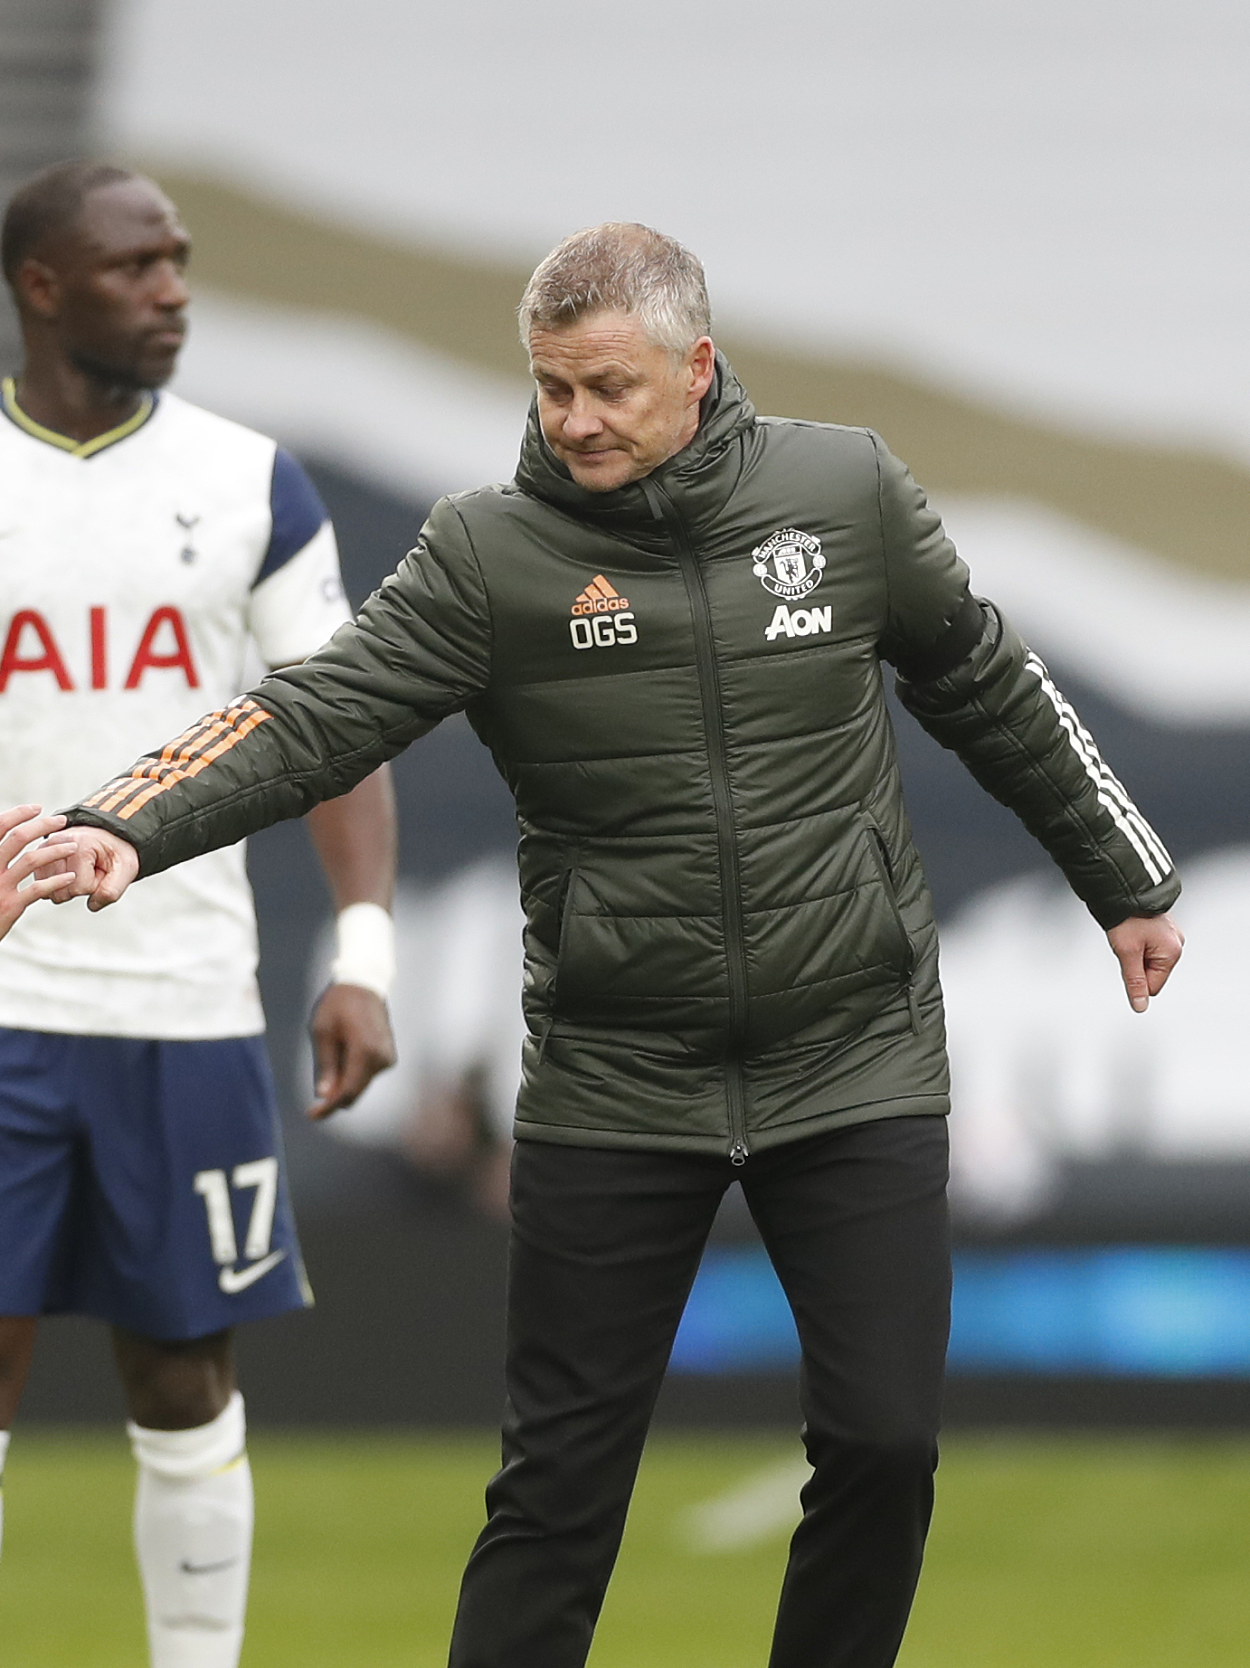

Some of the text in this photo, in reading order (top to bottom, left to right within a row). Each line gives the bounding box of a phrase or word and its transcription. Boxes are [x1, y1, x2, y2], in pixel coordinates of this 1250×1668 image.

[758, 531, 817, 560] MANCHESTER
[774, 579, 814, 596] UNITED
[570, 597, 630, 615] adidas
[569, 611, 638, 650] OGS
[193, 1156, 278, 1265] 17
